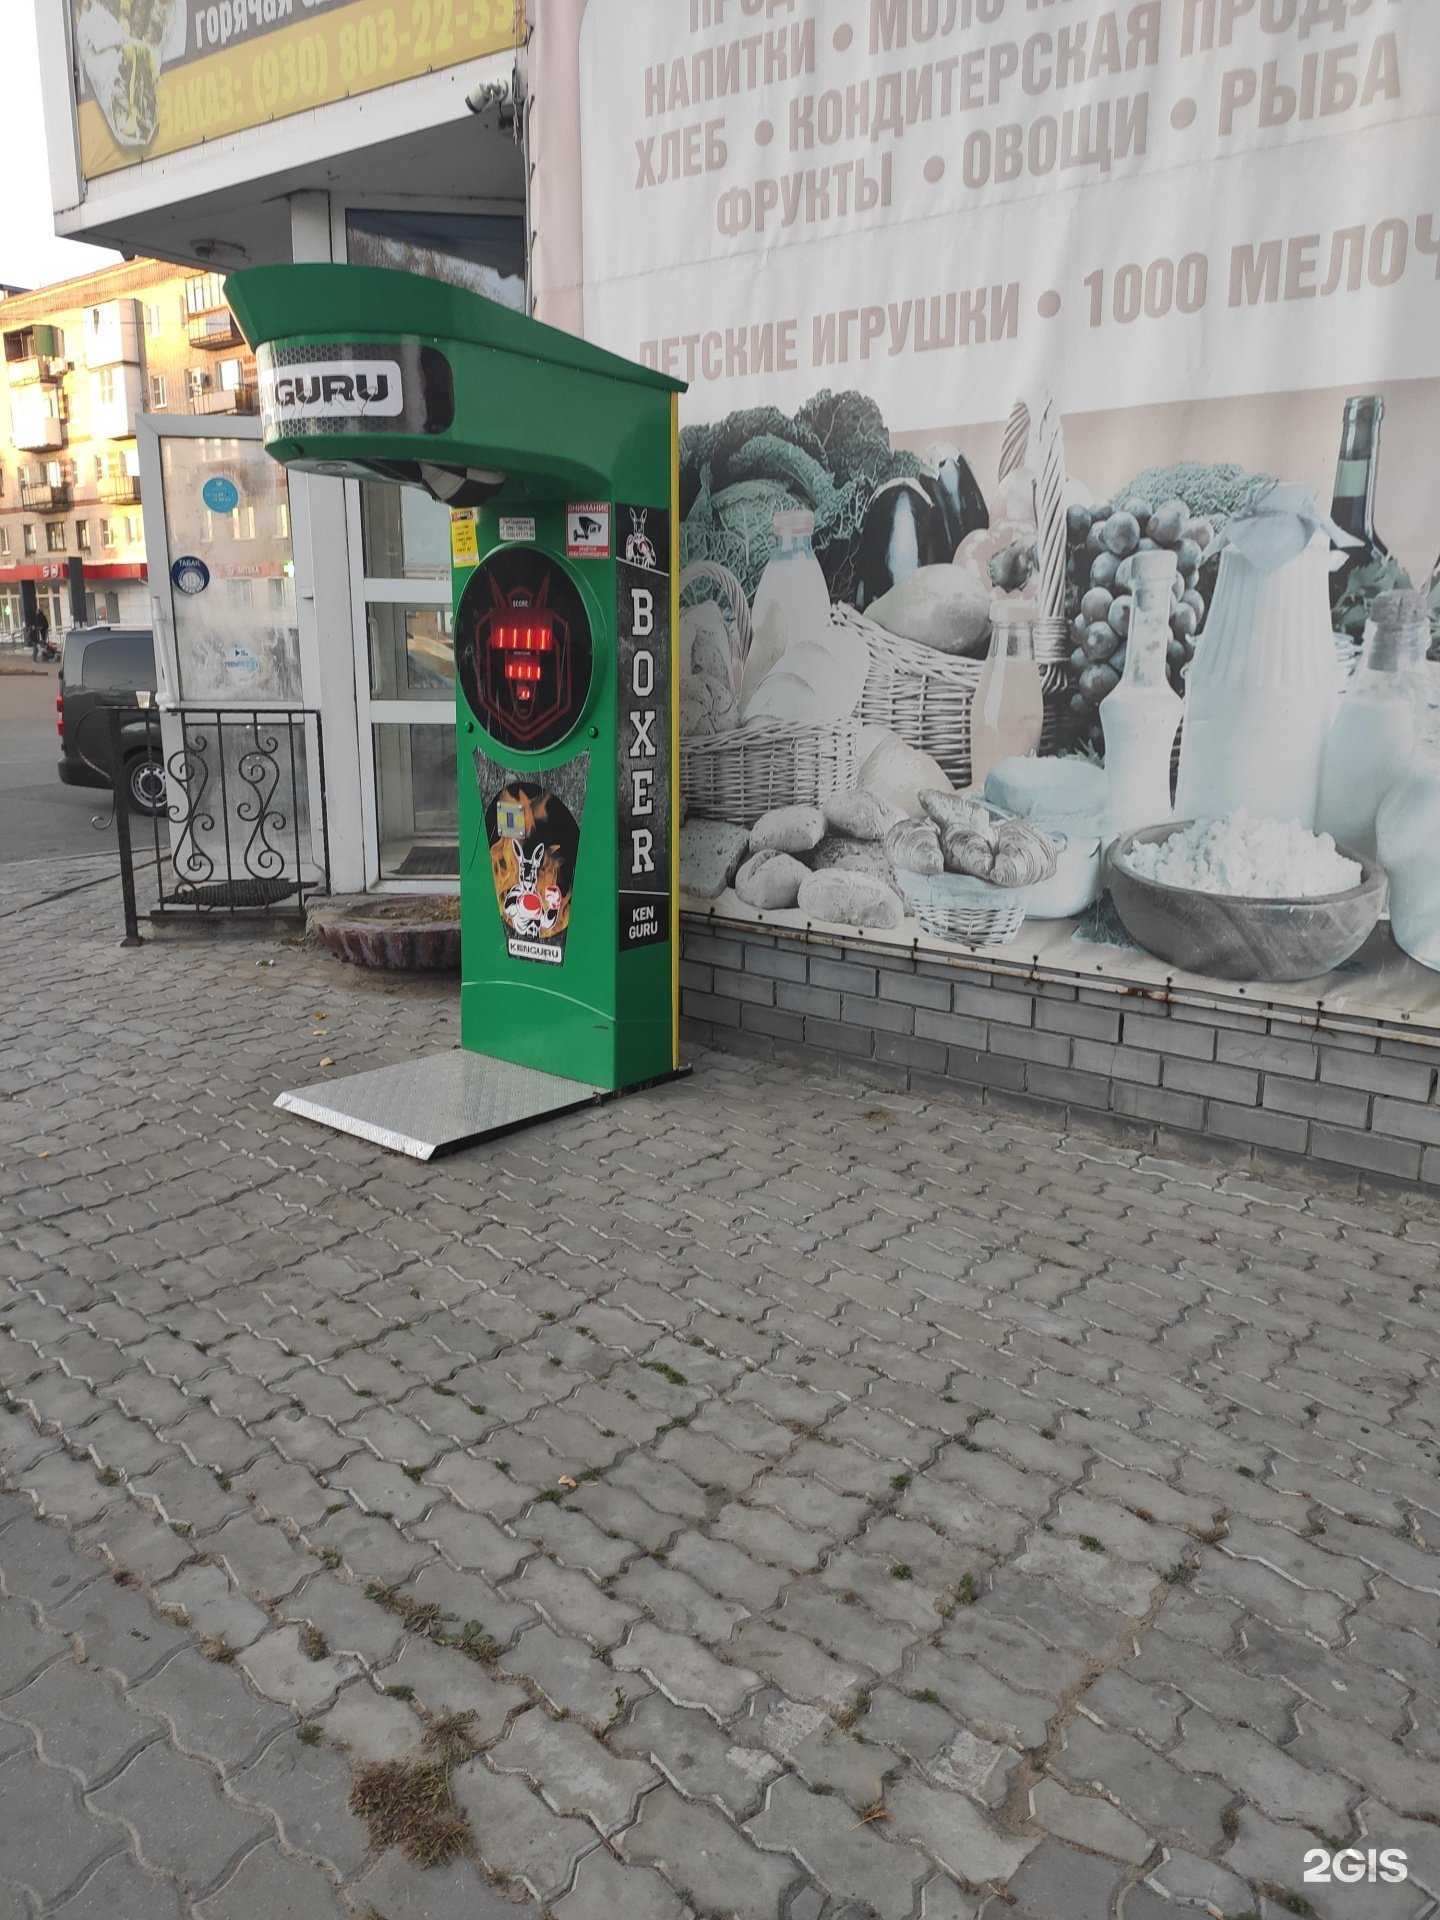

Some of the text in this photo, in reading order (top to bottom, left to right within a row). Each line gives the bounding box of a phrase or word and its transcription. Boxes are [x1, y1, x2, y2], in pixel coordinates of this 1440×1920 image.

[634, 117, 729, 190] ХЛЕБ
[788, 0, 1161, 152] КОНДИТЕРСКАЯ
[645, 17, 816, 118] НАПИТКИ
[716, 32, 1401, 237] ФРУКТЫ ОВОЩИ РЫБА
[811, 281, 1020, 367] ИГРУШКИ
[1083, 252, 1209, 328] 1000
[274, 373, 390, 407] GURU
[629, 587, 657, 875] BOXER
[510, 942, 559, 959] KENGURU
[628, 920, 658, 940] GURU
[632, 905, 654, 923] KEN
